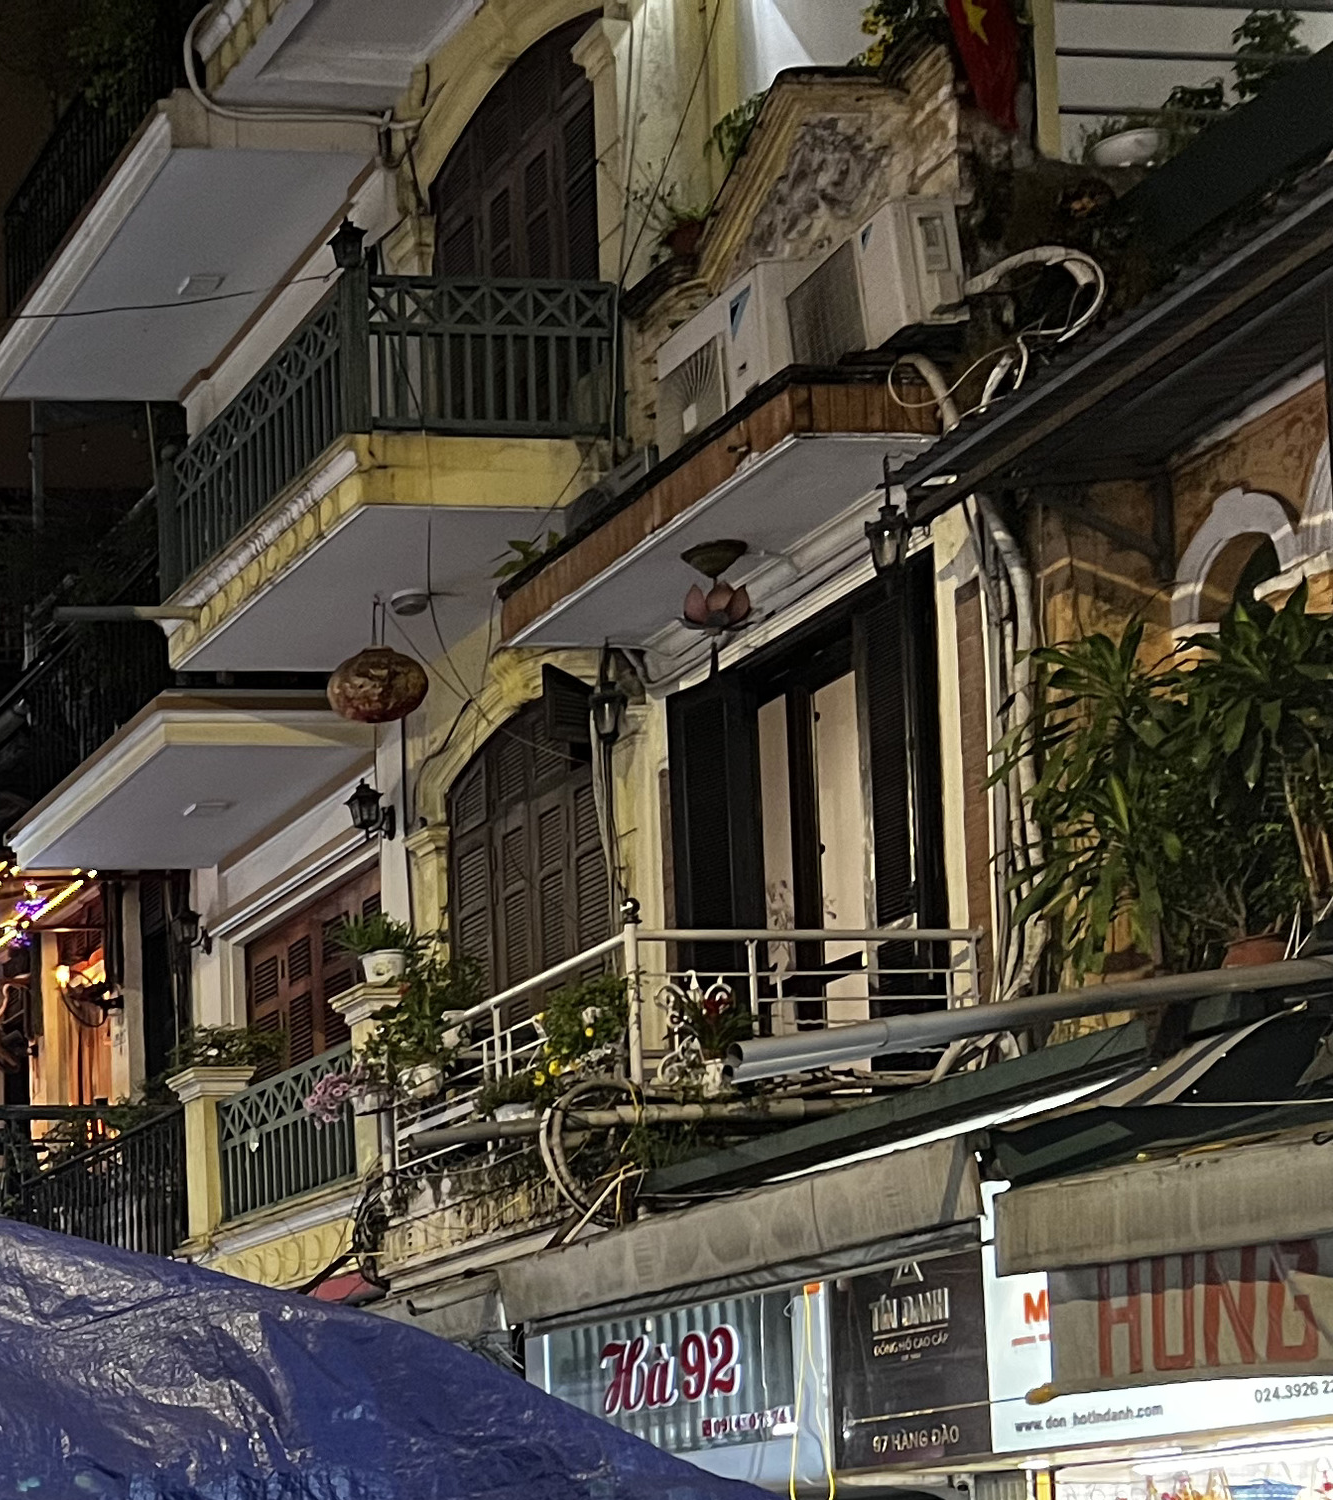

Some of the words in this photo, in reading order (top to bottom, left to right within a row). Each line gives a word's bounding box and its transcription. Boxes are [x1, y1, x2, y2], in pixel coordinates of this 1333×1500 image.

[869, 1293, 899, 1332] TÍN
[901, 1287, 950, 1327] DANH
[914, 1335, 932, 1350] CAO
[599, 1334, 679, 1417] Hà
[679, 1323, 741, 1402] 92
[873, 1435, 888, 1453] 97
[891, 1427, 929, 1452] HÀNG
[931, 1423, 960, 1446] ĐÀO
